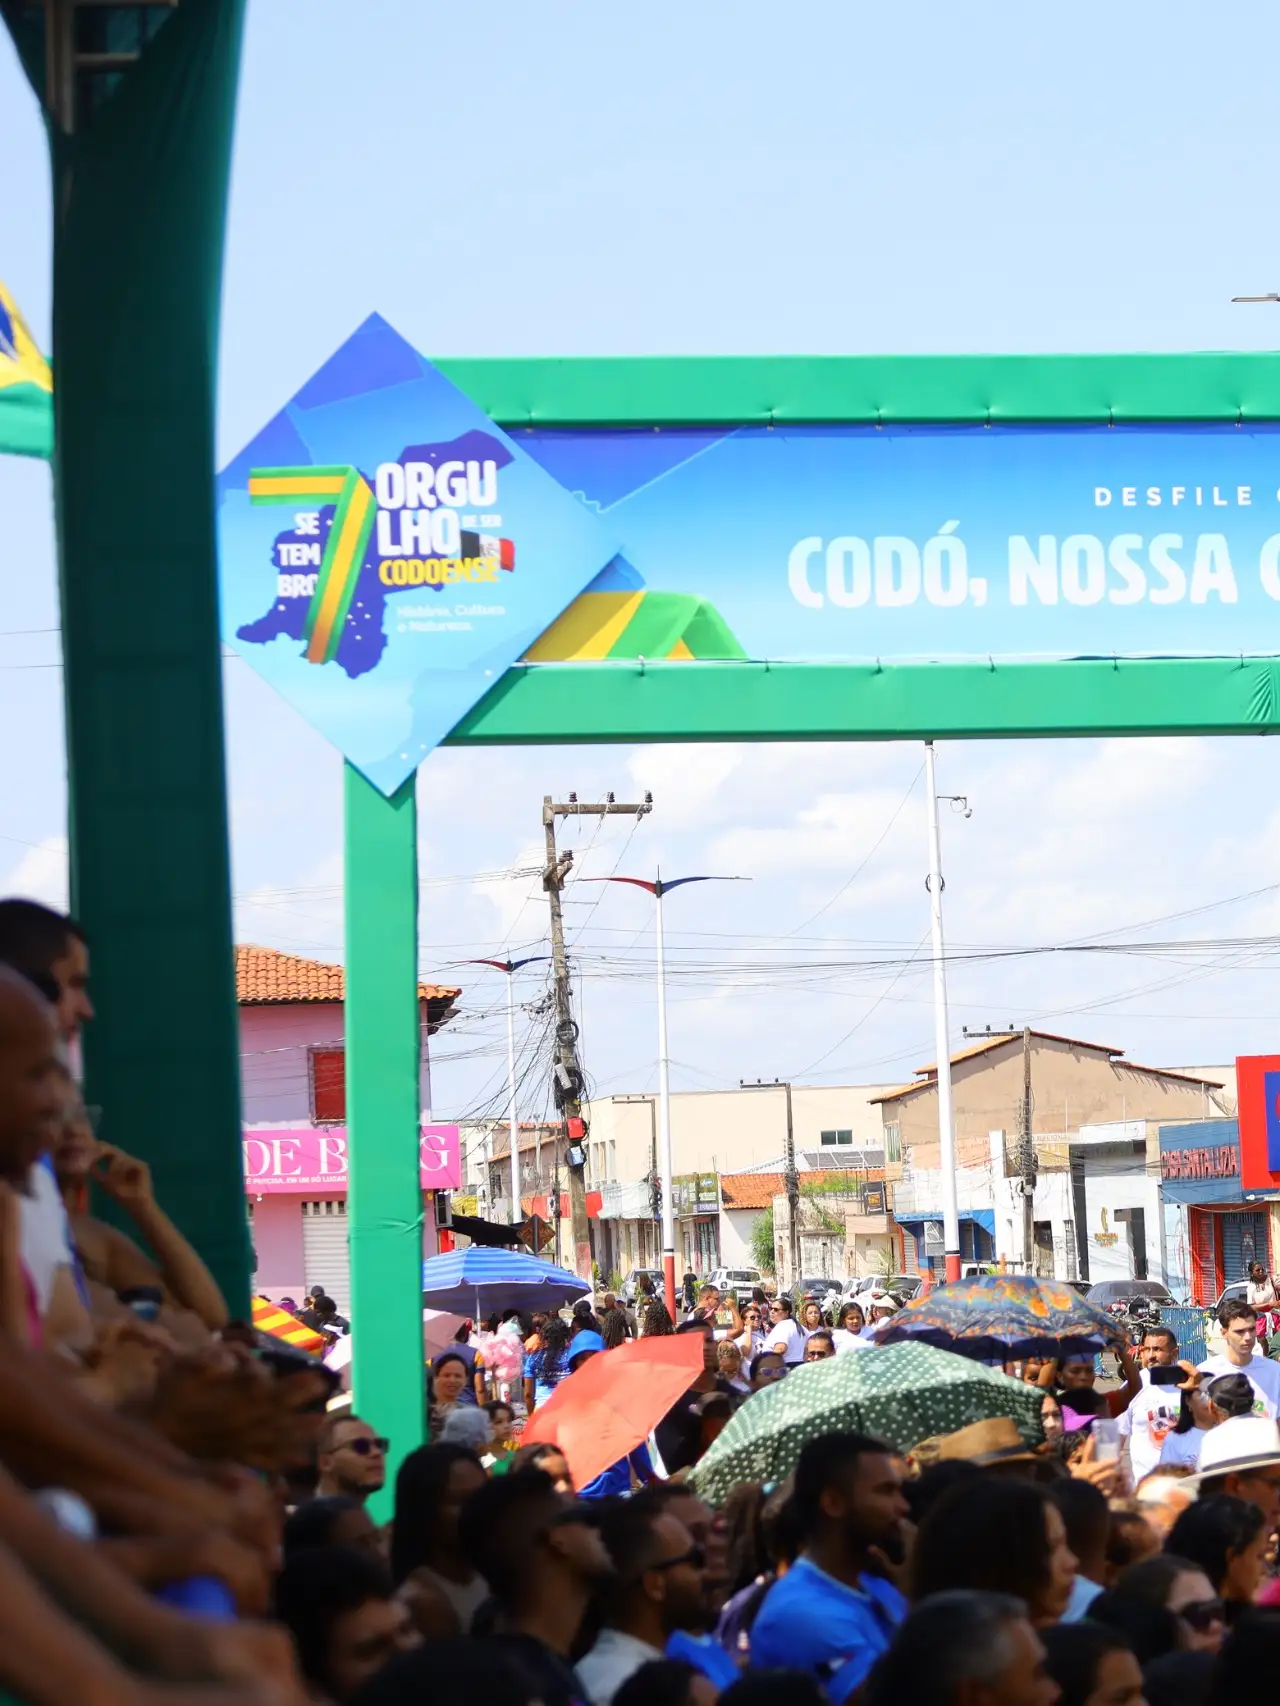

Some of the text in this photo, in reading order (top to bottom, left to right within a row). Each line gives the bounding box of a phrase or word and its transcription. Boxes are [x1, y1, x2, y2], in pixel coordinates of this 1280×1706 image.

[376, 460, 497, 509] ORGU
[1094, 486, 1251, 506] DESFILE
[294, 512, 320, 535] SE
[377, 509, 459, 556] LHO
[277, 543, 320, 566] TEM
[787, 519, 988, 609] CODÓ,
[1008, 532, 1238, 606] NOSSA
[379, 557, 499, 586] CODOENSE
[242, 1139, 301, 1177] DE
[310, 1175, 321, 1183] SÓ
